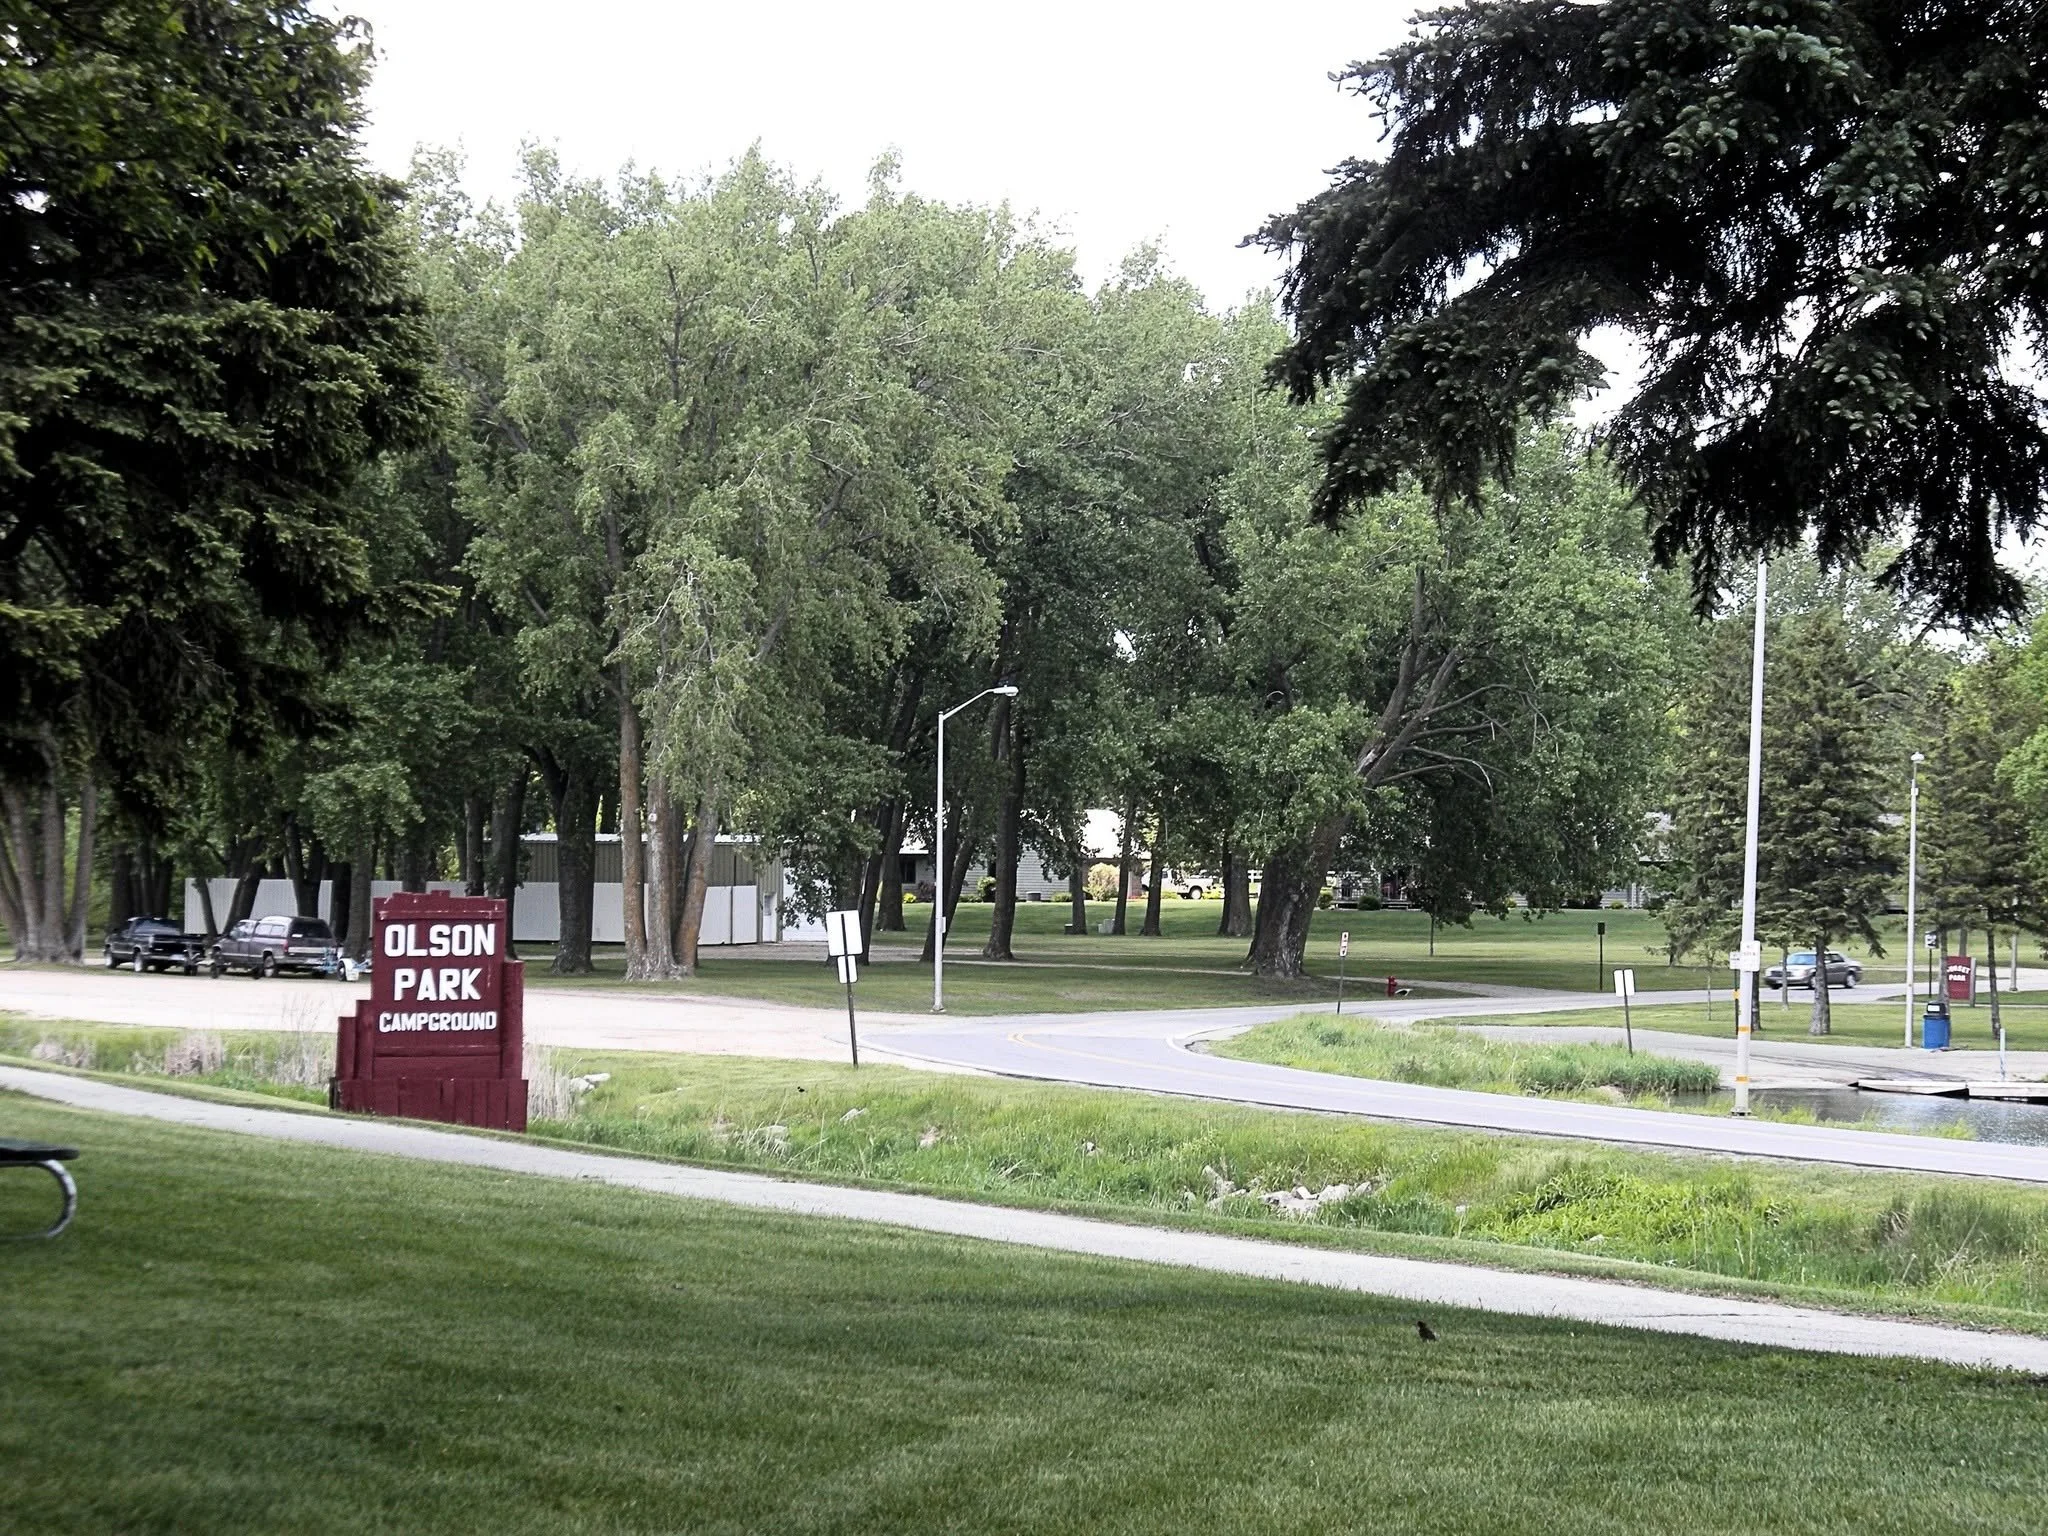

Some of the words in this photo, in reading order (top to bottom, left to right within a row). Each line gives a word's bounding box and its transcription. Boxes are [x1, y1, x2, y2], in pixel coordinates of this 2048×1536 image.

[384, 923, 496, 957] OLSON
[394, 967, 483, 1001] PARK
[379, 1011, 498, 1033] CAMPGROUND
